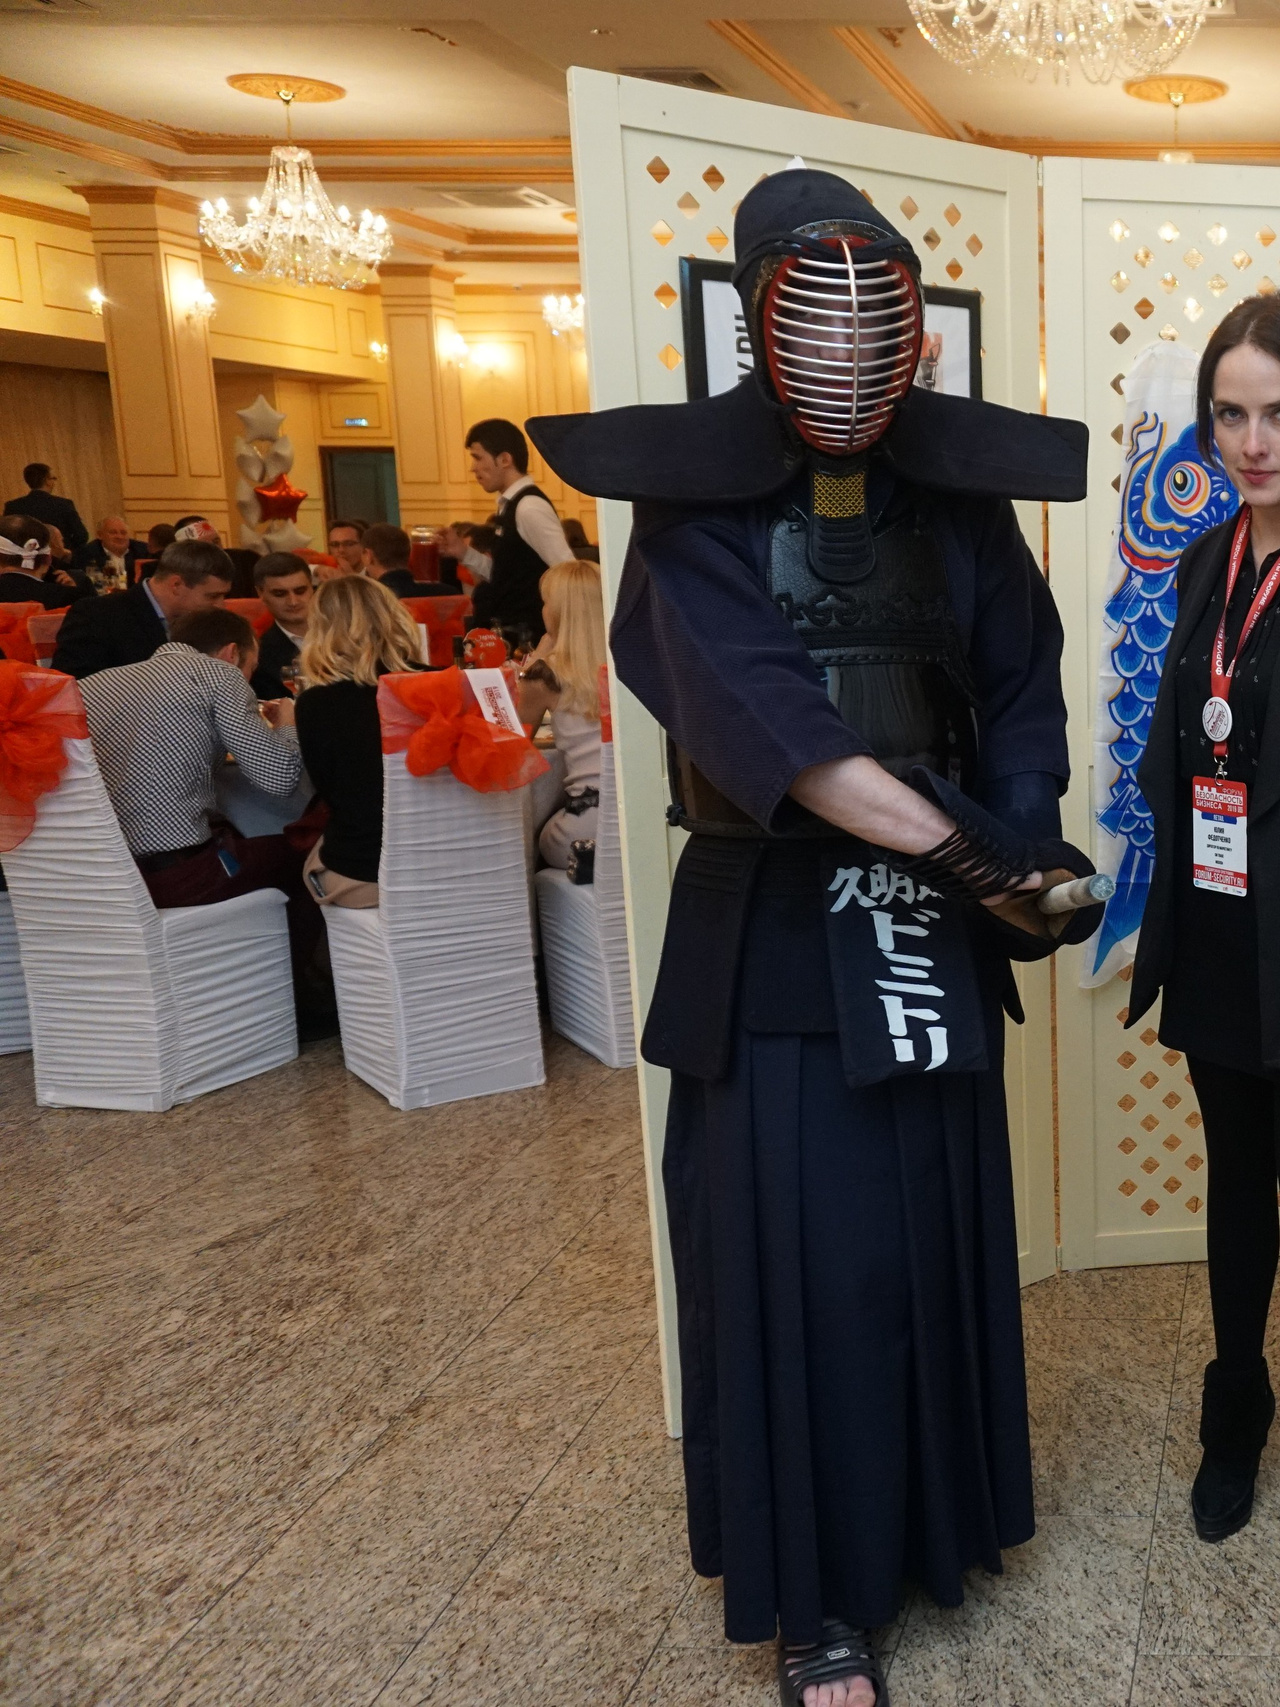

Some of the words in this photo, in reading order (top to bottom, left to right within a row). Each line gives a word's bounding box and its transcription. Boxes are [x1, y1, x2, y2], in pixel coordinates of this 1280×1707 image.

[1271, 572, 1279, 581] НА
[1259, 581, 1274, 606] ФОРУМЕ
[1215, 641, 1223, 676] ФОРУМ
[1196, 790, 1243, 805] БЕЗОПАСНОСТЬ
[1222, 787, 1243, 796] ФОРУМ
[1196, 799, 1223, 811] БИЗНЕСА
[827, 863, 945, 913] 久明
[1195, 868, 1245, 888] FORUM-SECURITY.RU
[869, 908, 949, 1071] ドミトリ
